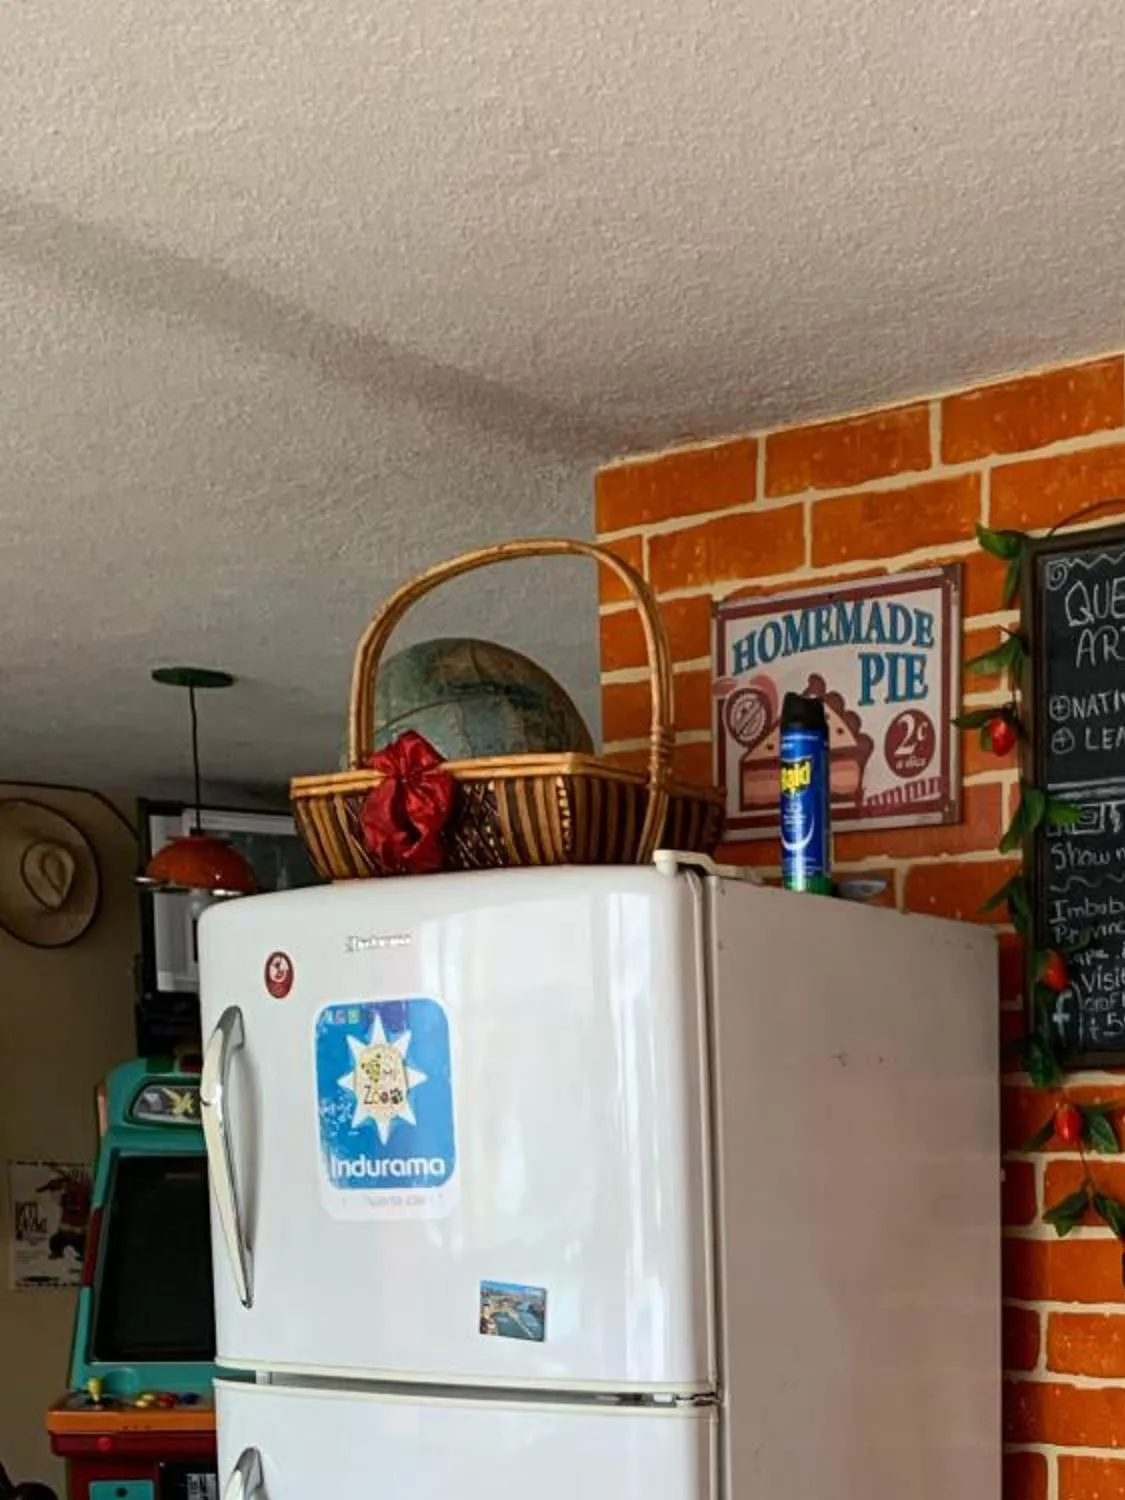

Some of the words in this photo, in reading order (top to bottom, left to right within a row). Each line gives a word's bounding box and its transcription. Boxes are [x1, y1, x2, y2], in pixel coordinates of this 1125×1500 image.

[732, 600, 935, 676] HOMEMADE
[857, 653, 929, 707] PIE
[1050, 841, 1111, 871] Show
[330, 1154, 446, 1179] Indurama
